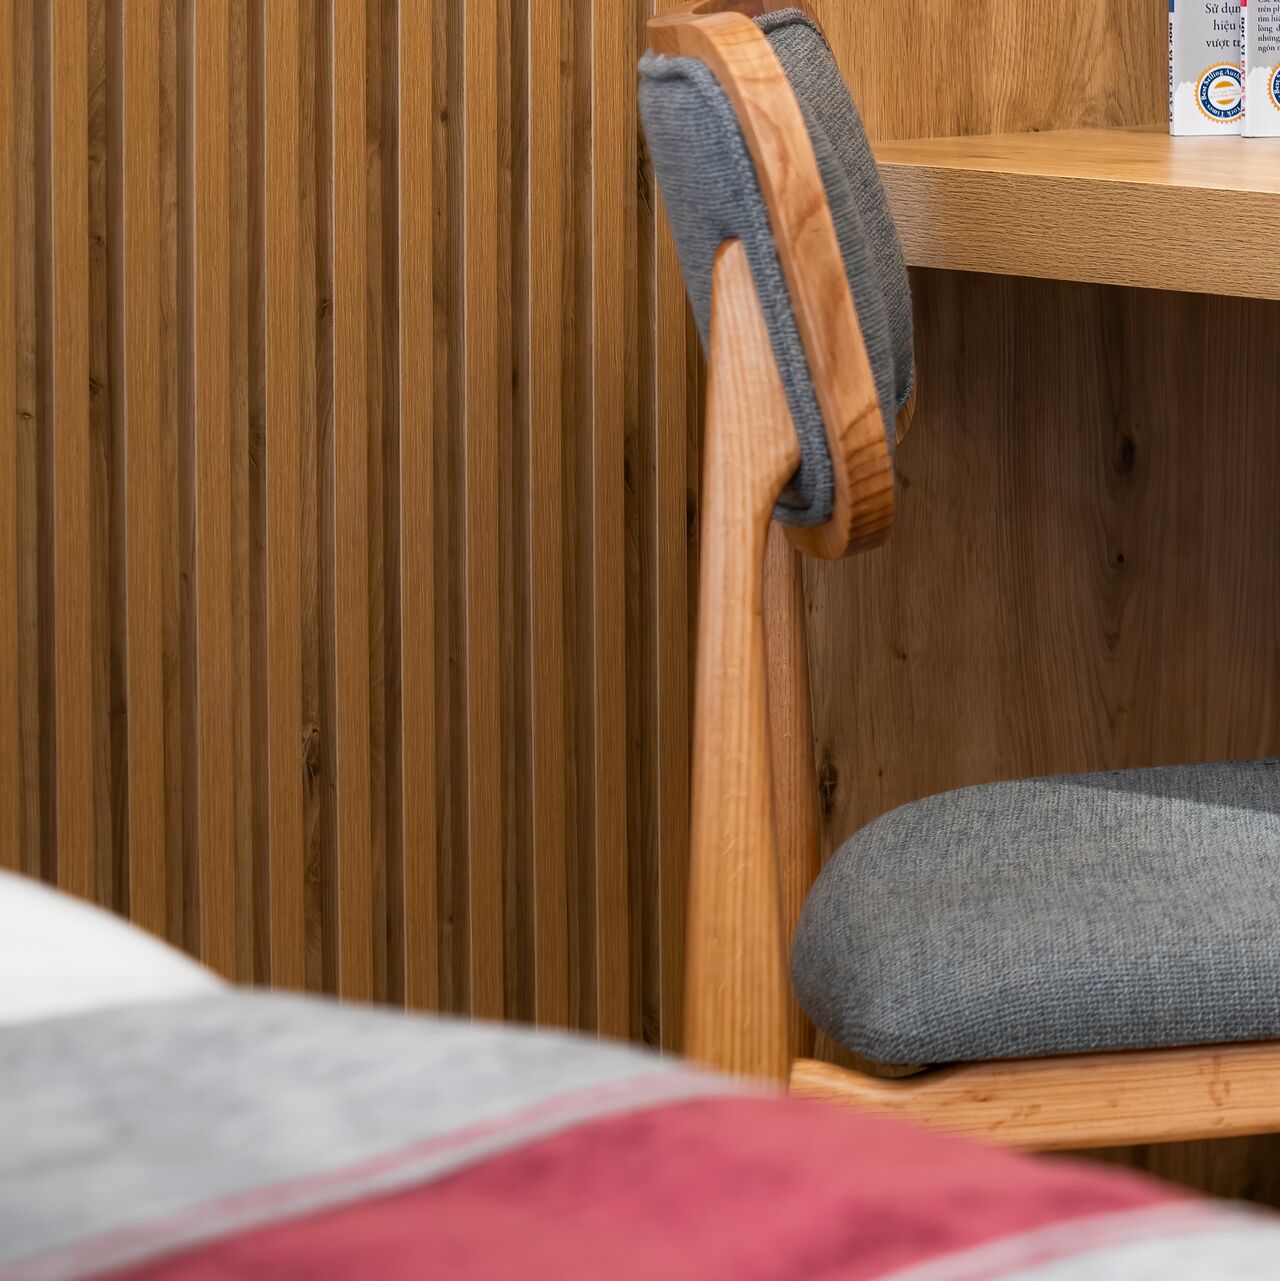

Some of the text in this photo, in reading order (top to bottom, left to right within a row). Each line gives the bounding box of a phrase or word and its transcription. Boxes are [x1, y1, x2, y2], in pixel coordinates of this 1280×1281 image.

[1221, 1, 1240, 16] dụn
[1213, 19, 1236, 33] hiệu
[1224, 69, 1241, 81] Auth
